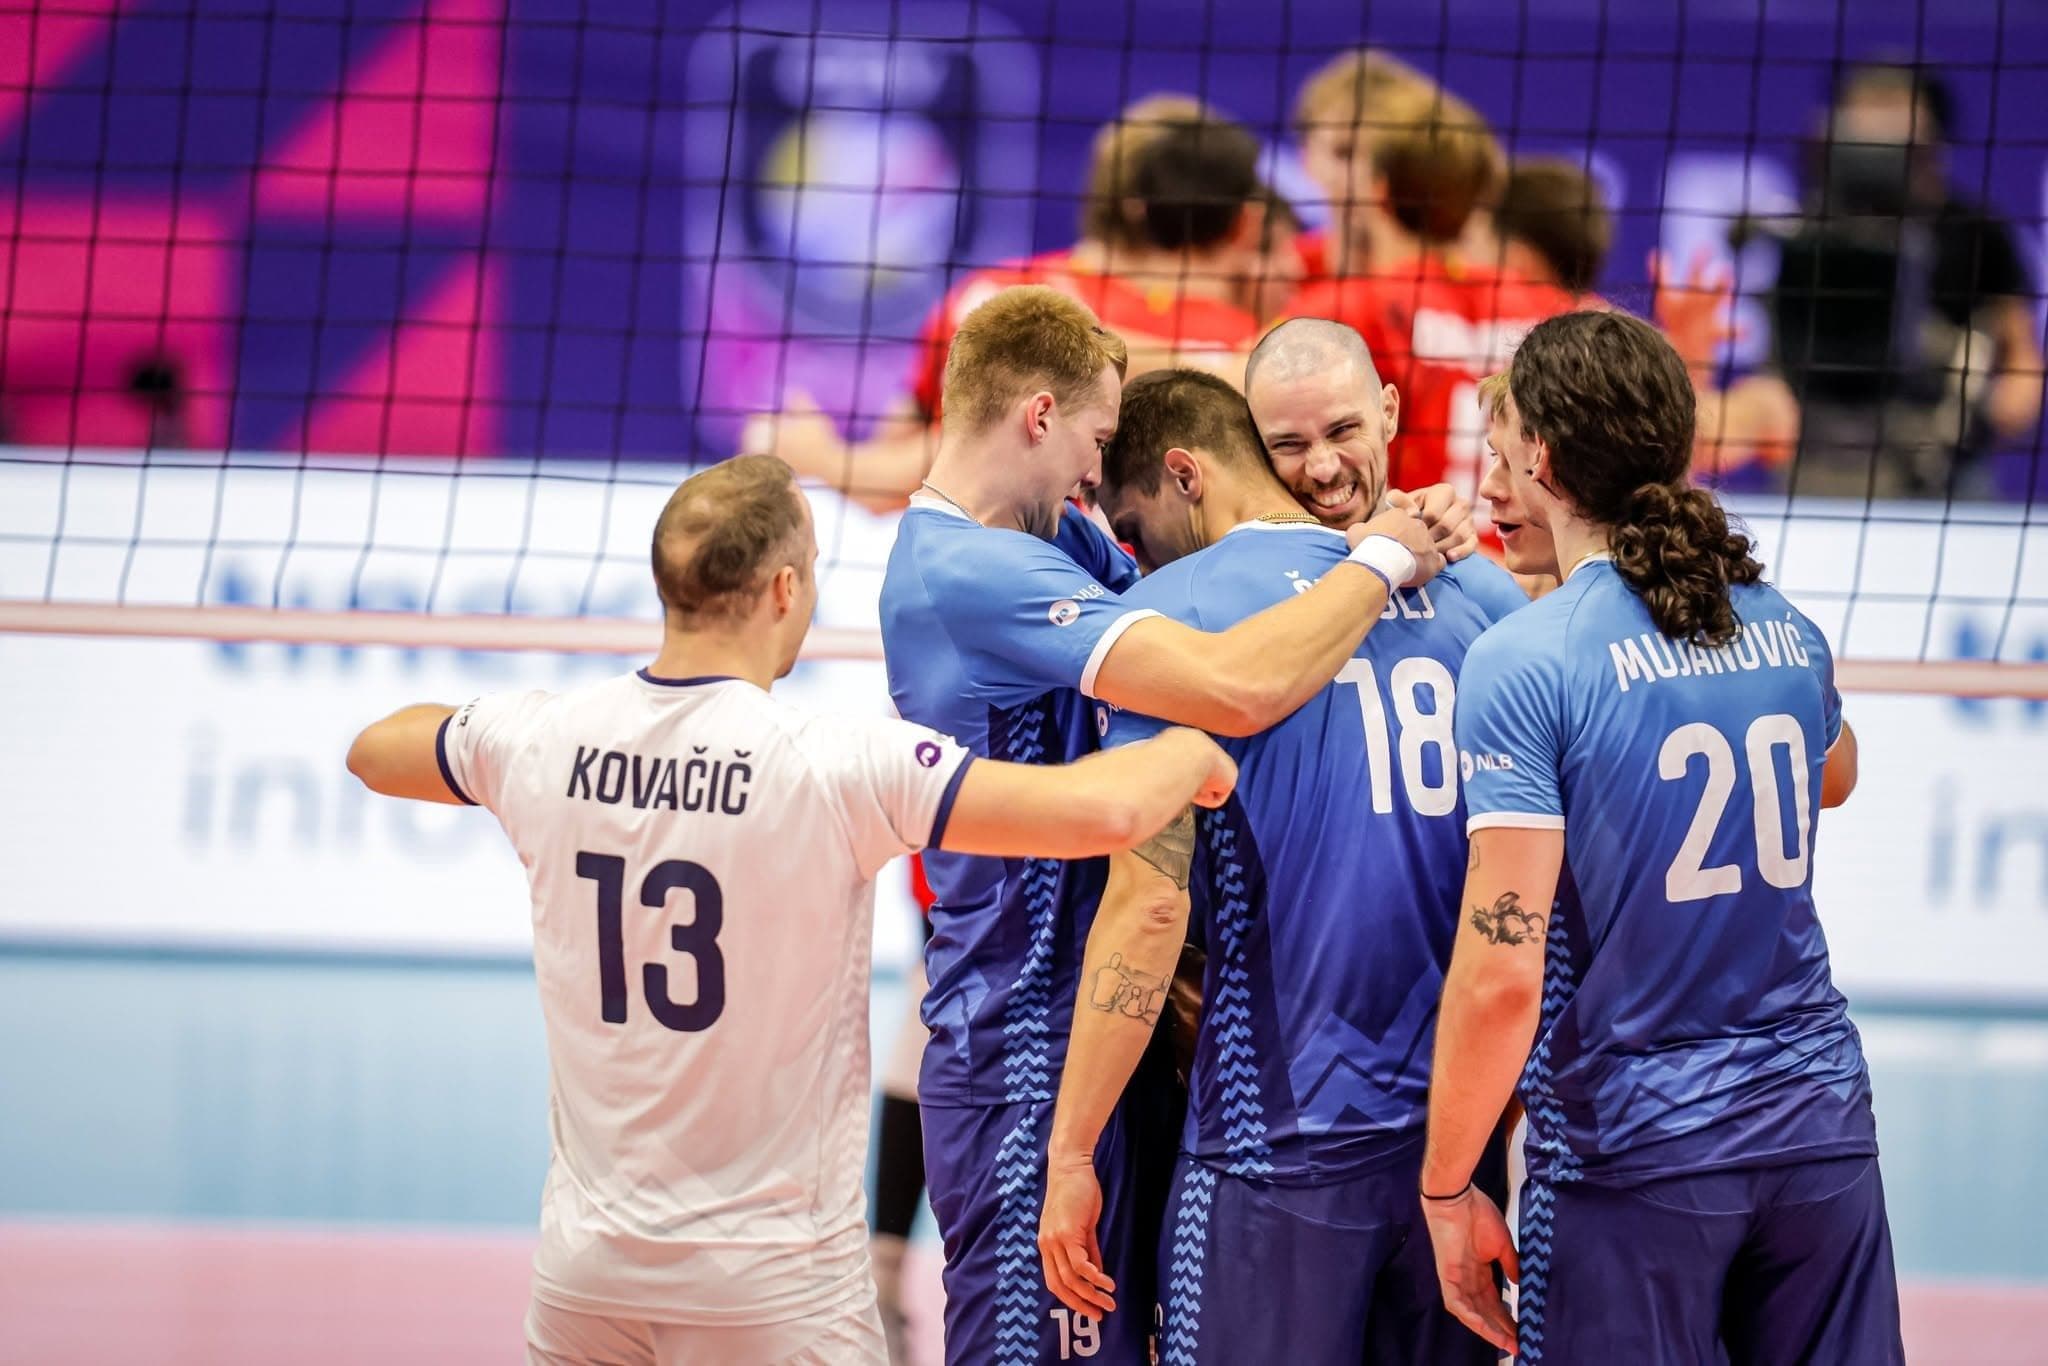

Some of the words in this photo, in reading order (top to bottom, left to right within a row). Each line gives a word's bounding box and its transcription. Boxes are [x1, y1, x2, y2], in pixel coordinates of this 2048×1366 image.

[1609, 611, 1810, 692] MUJANOVIĆ
[1334, 657, 1458, 817] 18
[1476, 752, 1514, 771] NLB
[566, 745, 752, 816] KOVAČIČ
[1658, 713, 1810, 903] 20
[576, 851, 725, 1032] 13
[1050, 1309, 1100, 1360] 19
